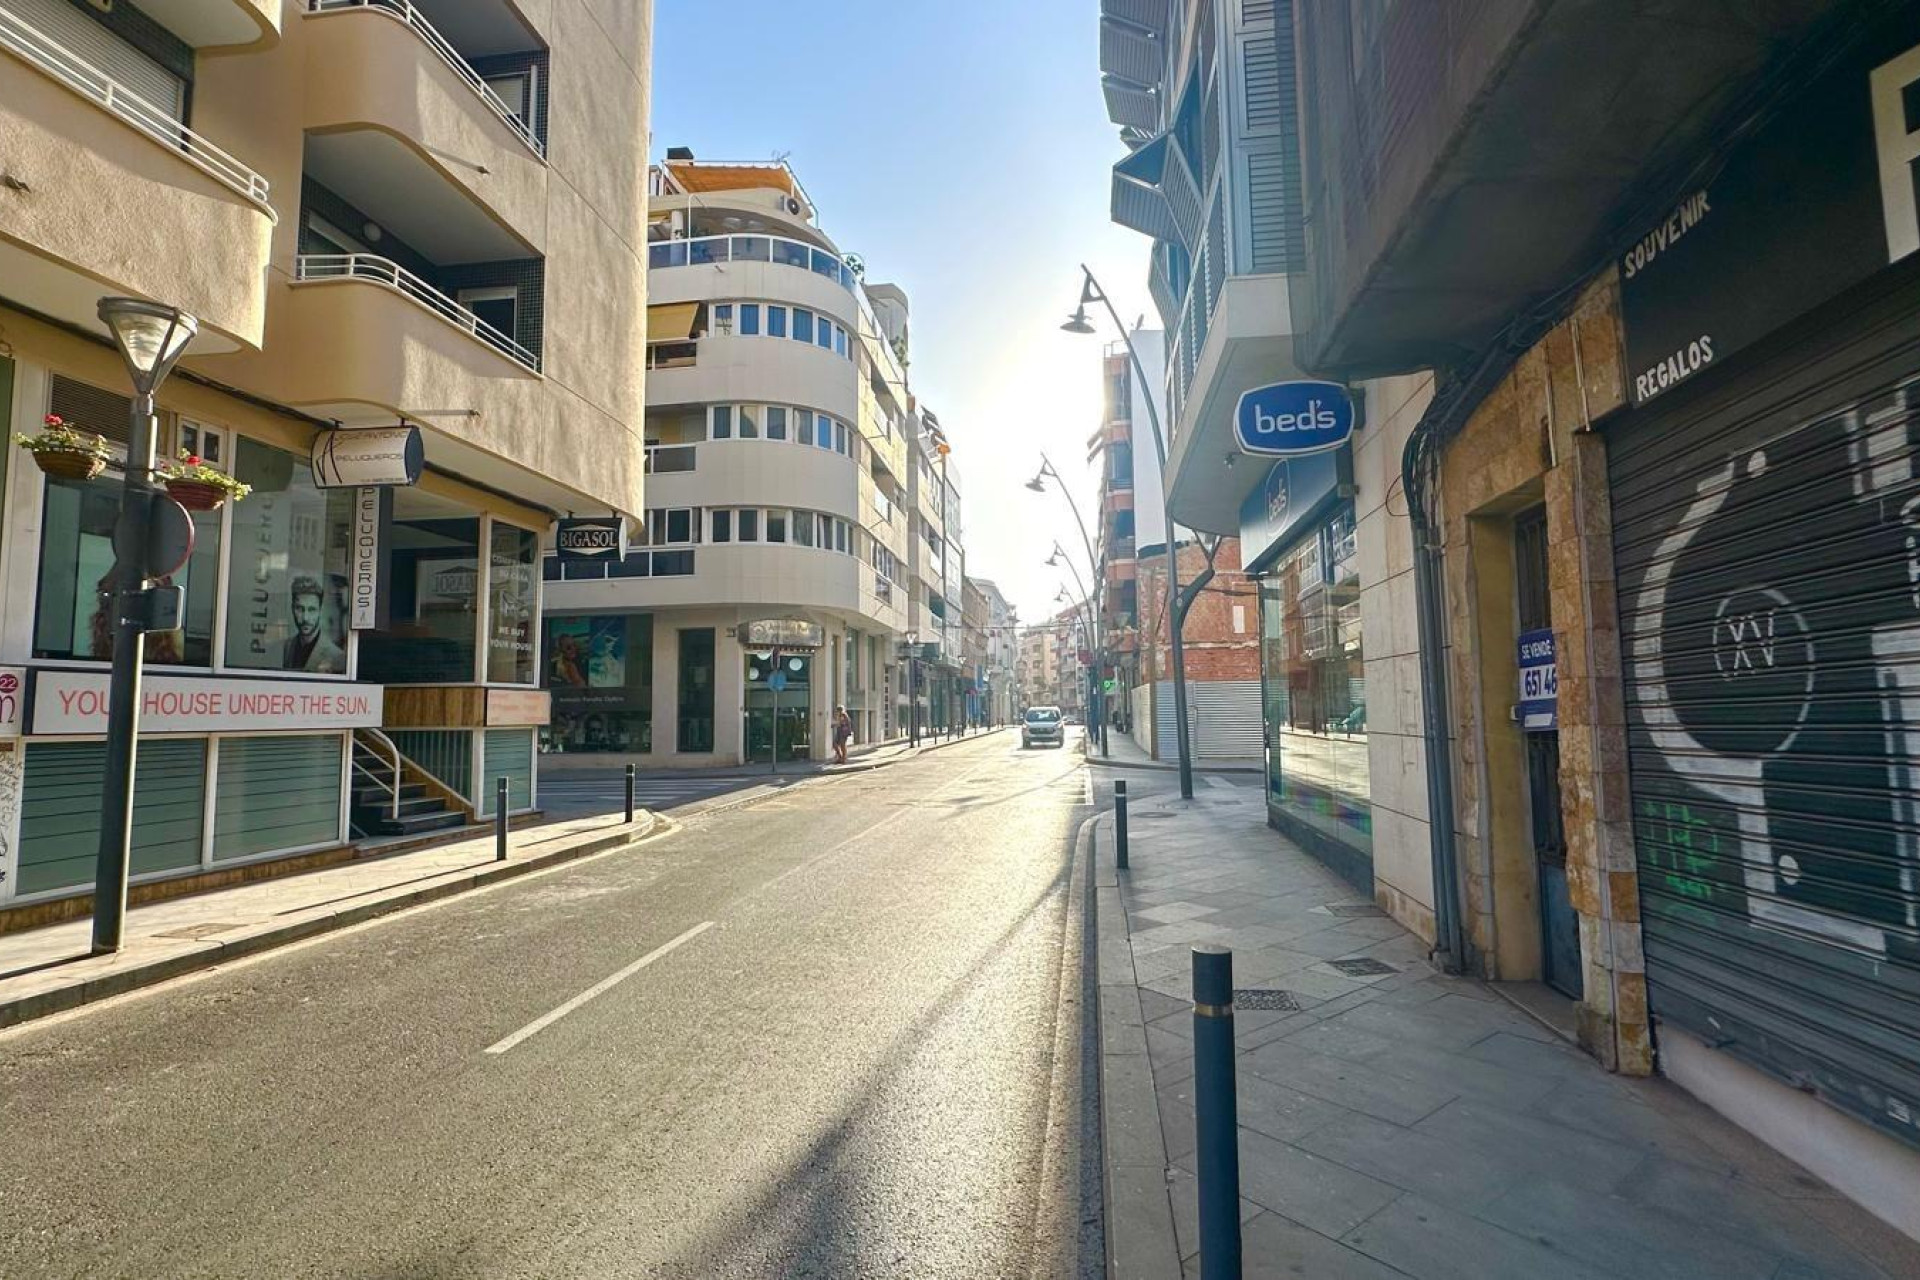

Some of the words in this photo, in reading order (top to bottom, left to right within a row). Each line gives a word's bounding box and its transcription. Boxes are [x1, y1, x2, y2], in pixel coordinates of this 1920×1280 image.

[1625, 189, 1711, 279] SOUVENIR
[1636, 335, 1714, 402] REGALOS
[1255, 399, 1337, 433] bed's
[335, 453, 404, 462] PELUQUEROS
[358, 487, 376, 608] PELUQUEROS
[560, 531, 617, 547] BIGASOL
[59, 690, 110, 715] YOU
[143, 692, 222, 715] HOUSE
[228, 694, 295, 715] UNDER
[299, 694, 332, 715] THE
[335, 696, 371, 715] SUN.
